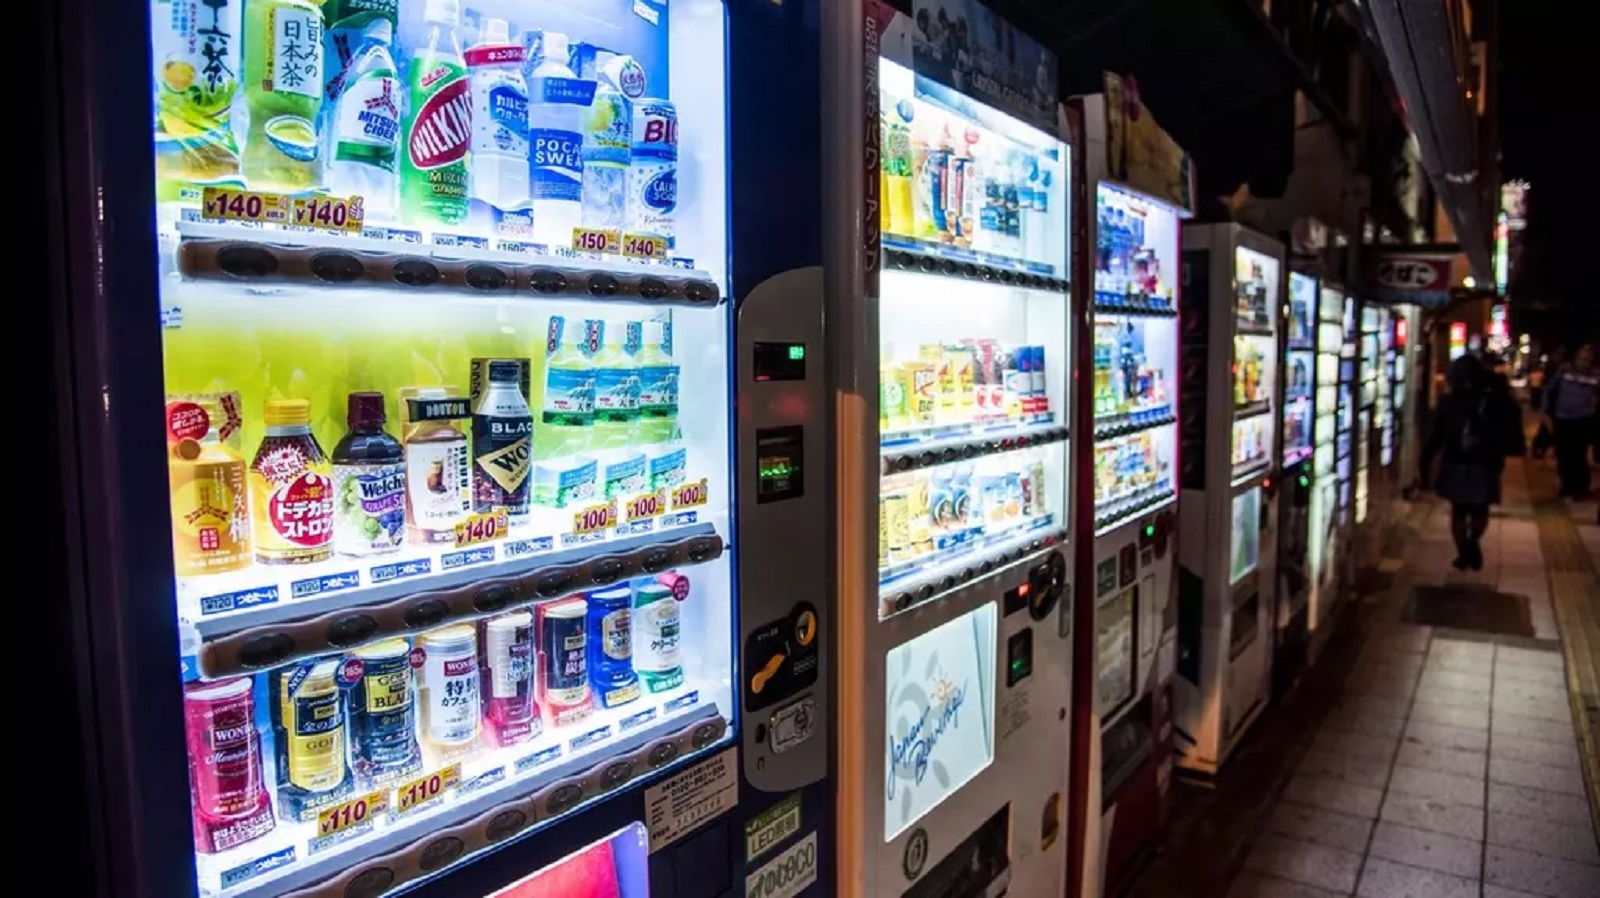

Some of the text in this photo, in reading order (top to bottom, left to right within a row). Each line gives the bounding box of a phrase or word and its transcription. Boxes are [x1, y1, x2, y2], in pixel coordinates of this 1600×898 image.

[281, 20, 304, 86] 日本茶
[304, 16, 319, 77] 旨みの
[206, 193, 262, 217] ¥140
[296, 199, 346, 227] ¥140
[575, 232, 606, 250] ¥150
[626, 238, 653, 256] ¥140
[628, 497, 656, 517] ¥100
[673, 487, 698, 505] ¥100
[457, 516, 496, 544] ¥140
[576, 509, 607, 529] ¥100
[402, 775, 440, 807] ¥110
[322, 800, 366, 832] ¥110
